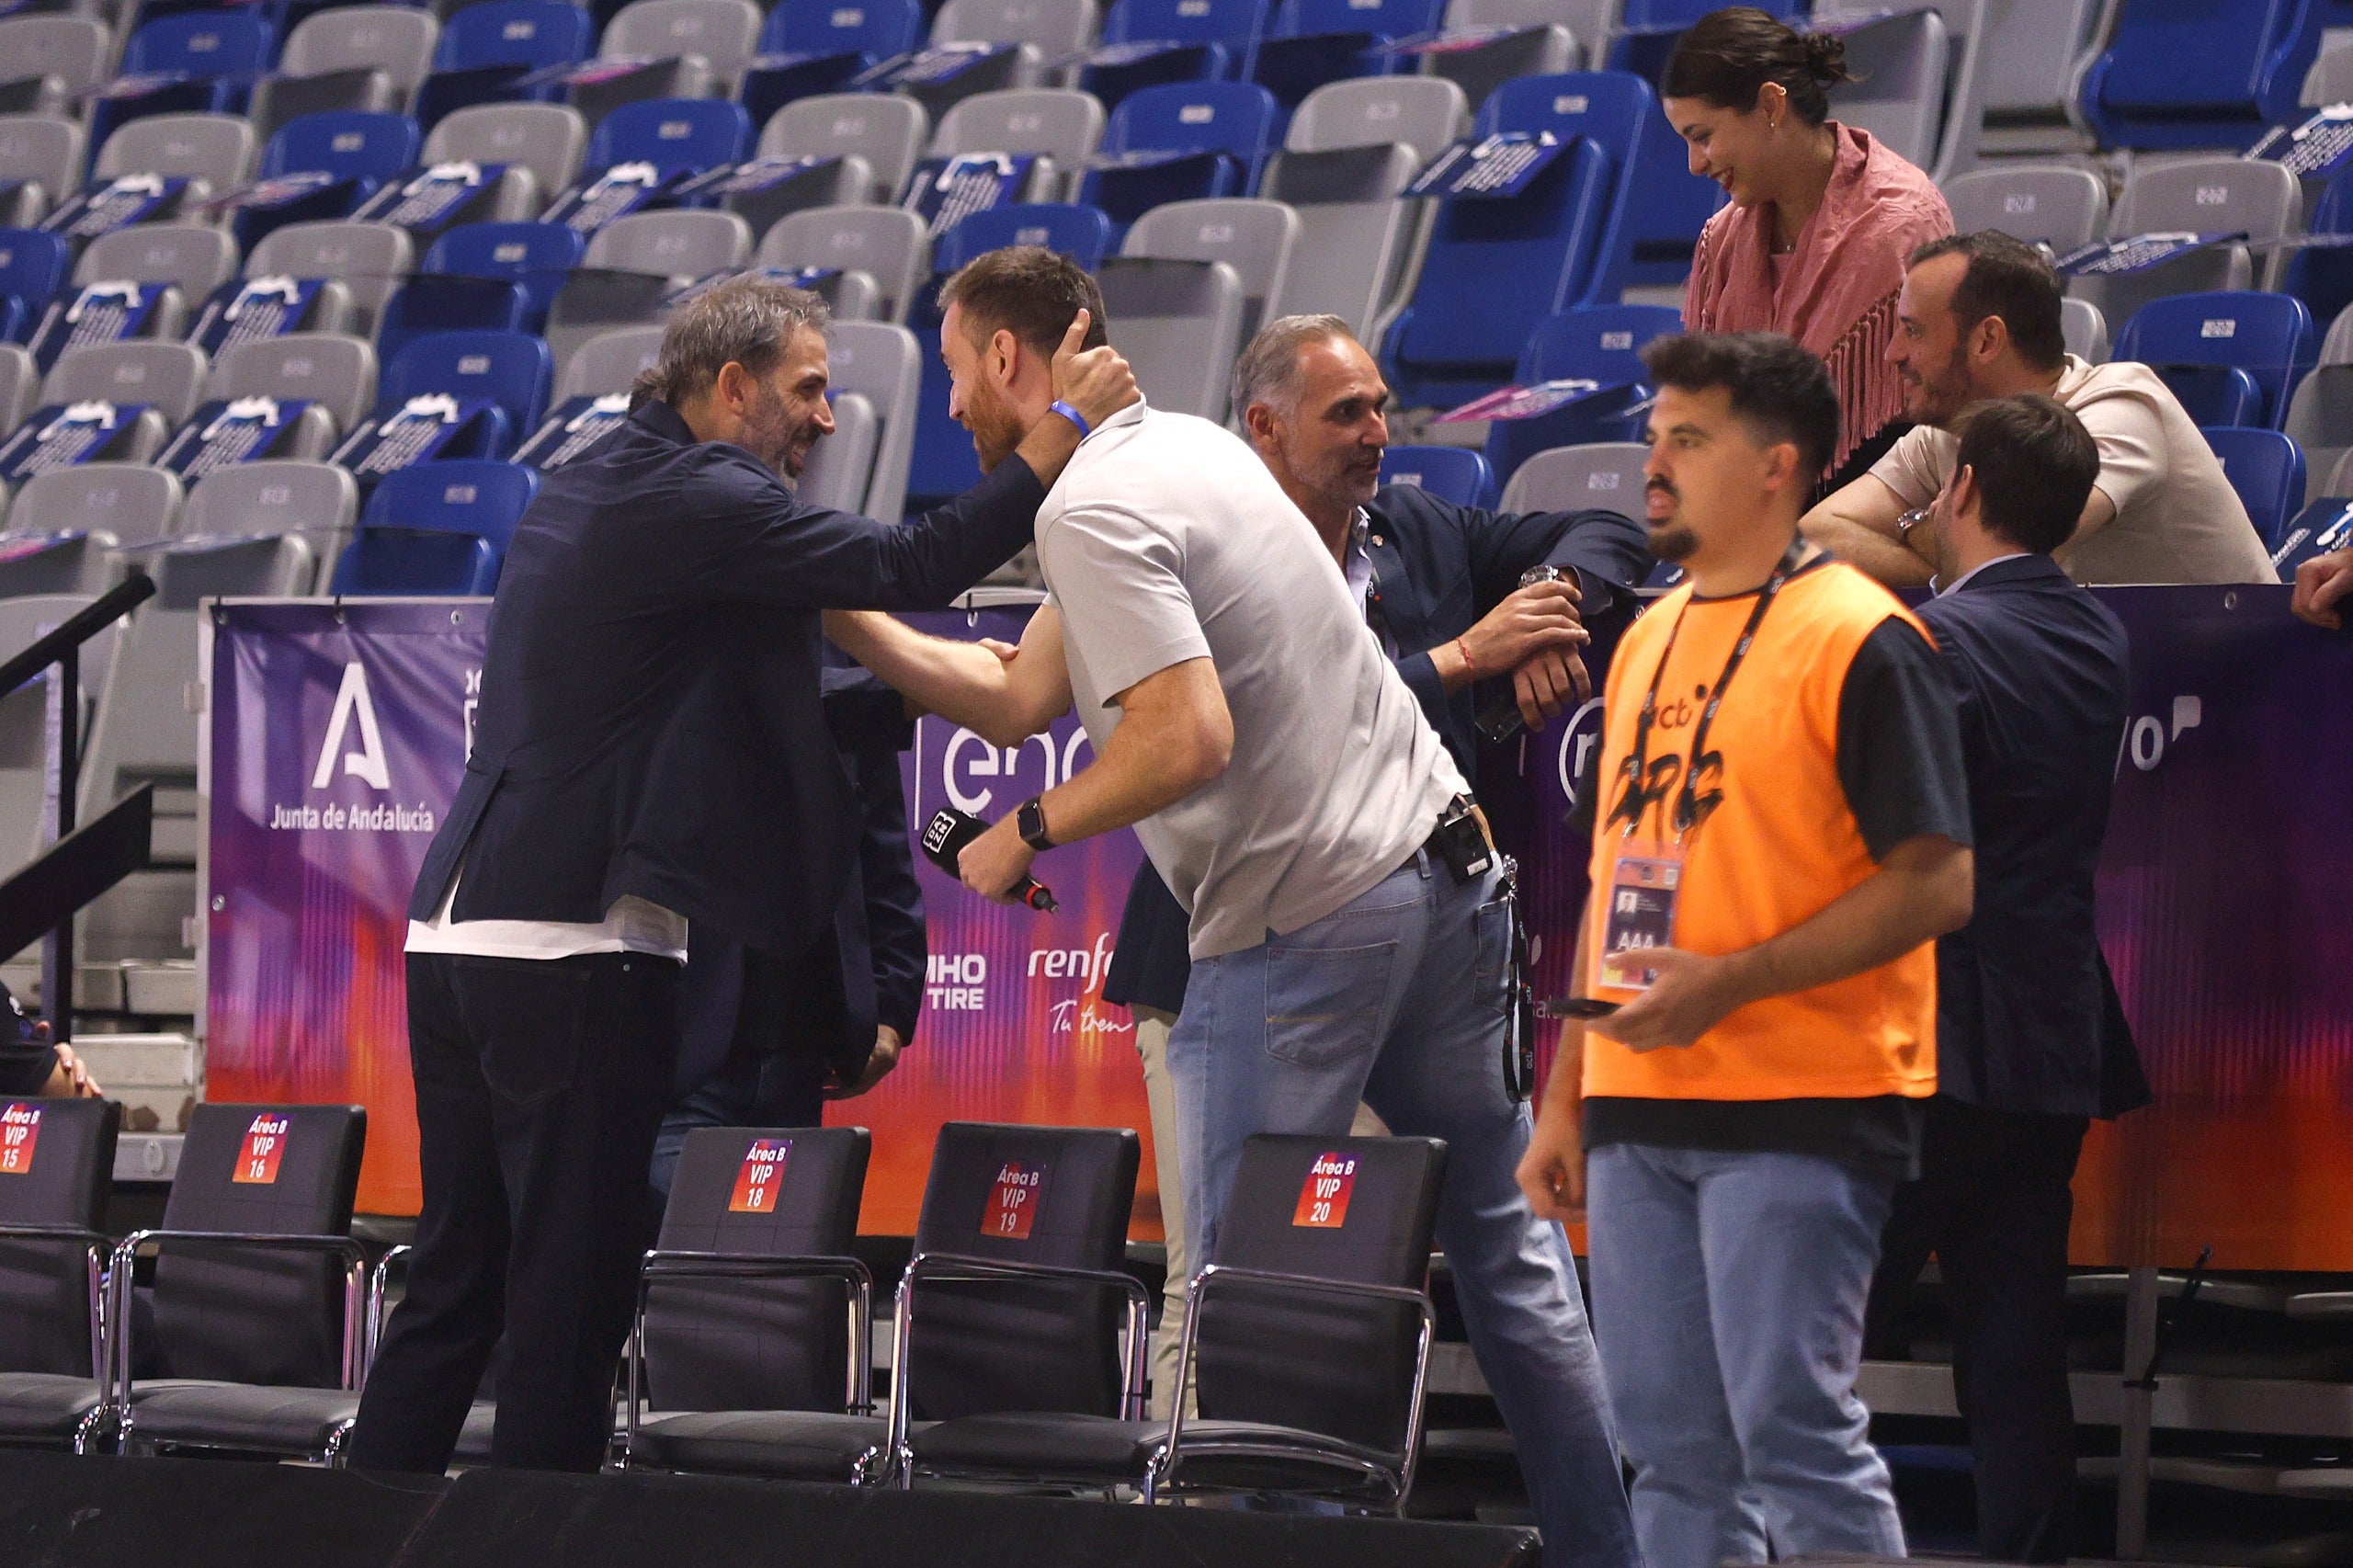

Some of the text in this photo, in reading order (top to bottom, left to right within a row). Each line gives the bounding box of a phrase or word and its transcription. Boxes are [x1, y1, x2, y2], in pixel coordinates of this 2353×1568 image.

[271, 801, 434, 831] Junta de Andalucía
[926, 987, 985, 1010] TIRE
[1050, 999, 1133, 1034] Tu tren
[0, 1104, 41, 1125] Área B
[248, 1115, 288, 1134] Área B
[5, 1126, 28, 1146] VIP
[253, 1136, 275, 1156] VIP
[2, 1148, 19, 1169] 15
[745, 1142, 787, 1162] Área B
[249, 1159, 265, 1178] 16
[750, 1165, 773, 1184] VIP
[997, 1164, 1040, 1187] Área B
[1311, 1155, 1356, 1176] Área B
[746, 1187, 764, 1208] 18
[1002, 1187, 1027, 1209] VIP
[1315, 1178, 1341, 1199] VIP
[1310, 1201, 1331, 1222] 20
[1000, 1212, 1017, 1233] 19
